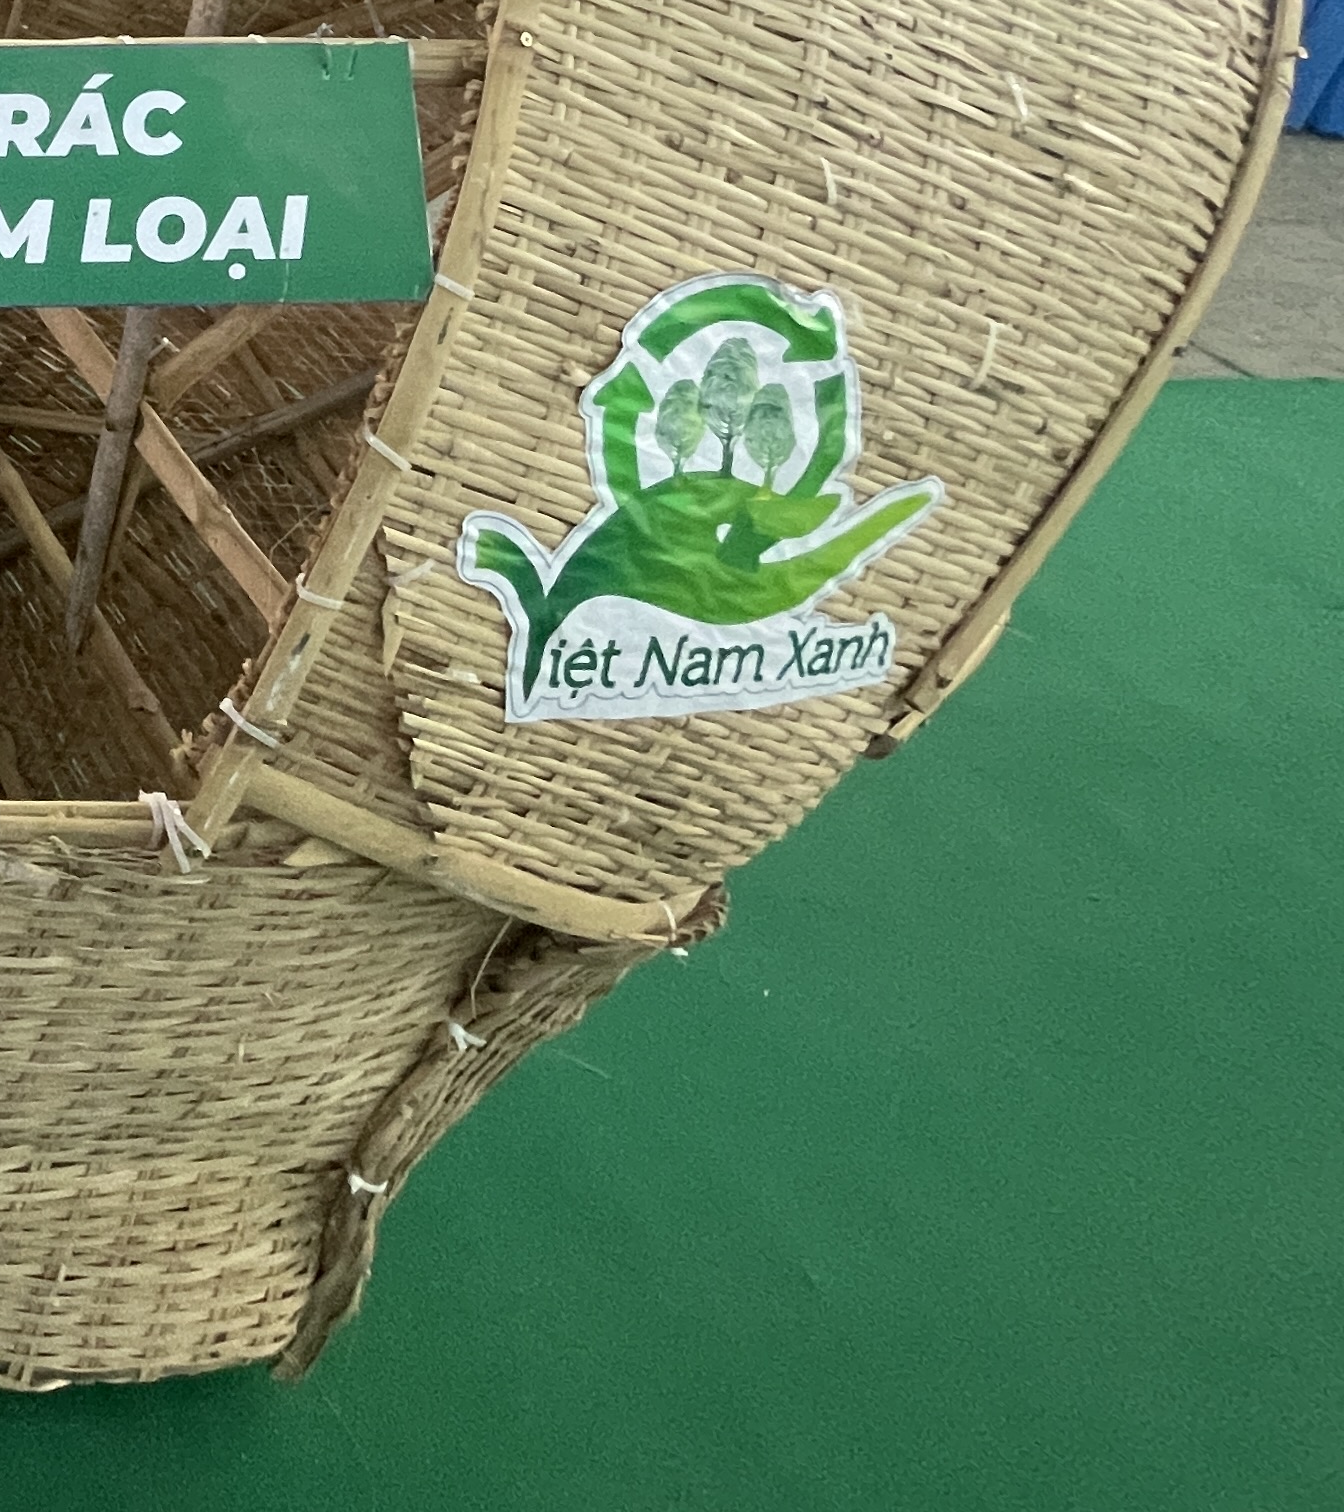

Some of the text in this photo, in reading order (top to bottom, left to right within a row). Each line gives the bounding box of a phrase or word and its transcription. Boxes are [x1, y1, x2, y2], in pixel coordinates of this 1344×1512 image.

[80, 195, 309, 280] LOẠI
[633, 635, 766, 689] Nam
[778, 617, 890, 681] Xanh
